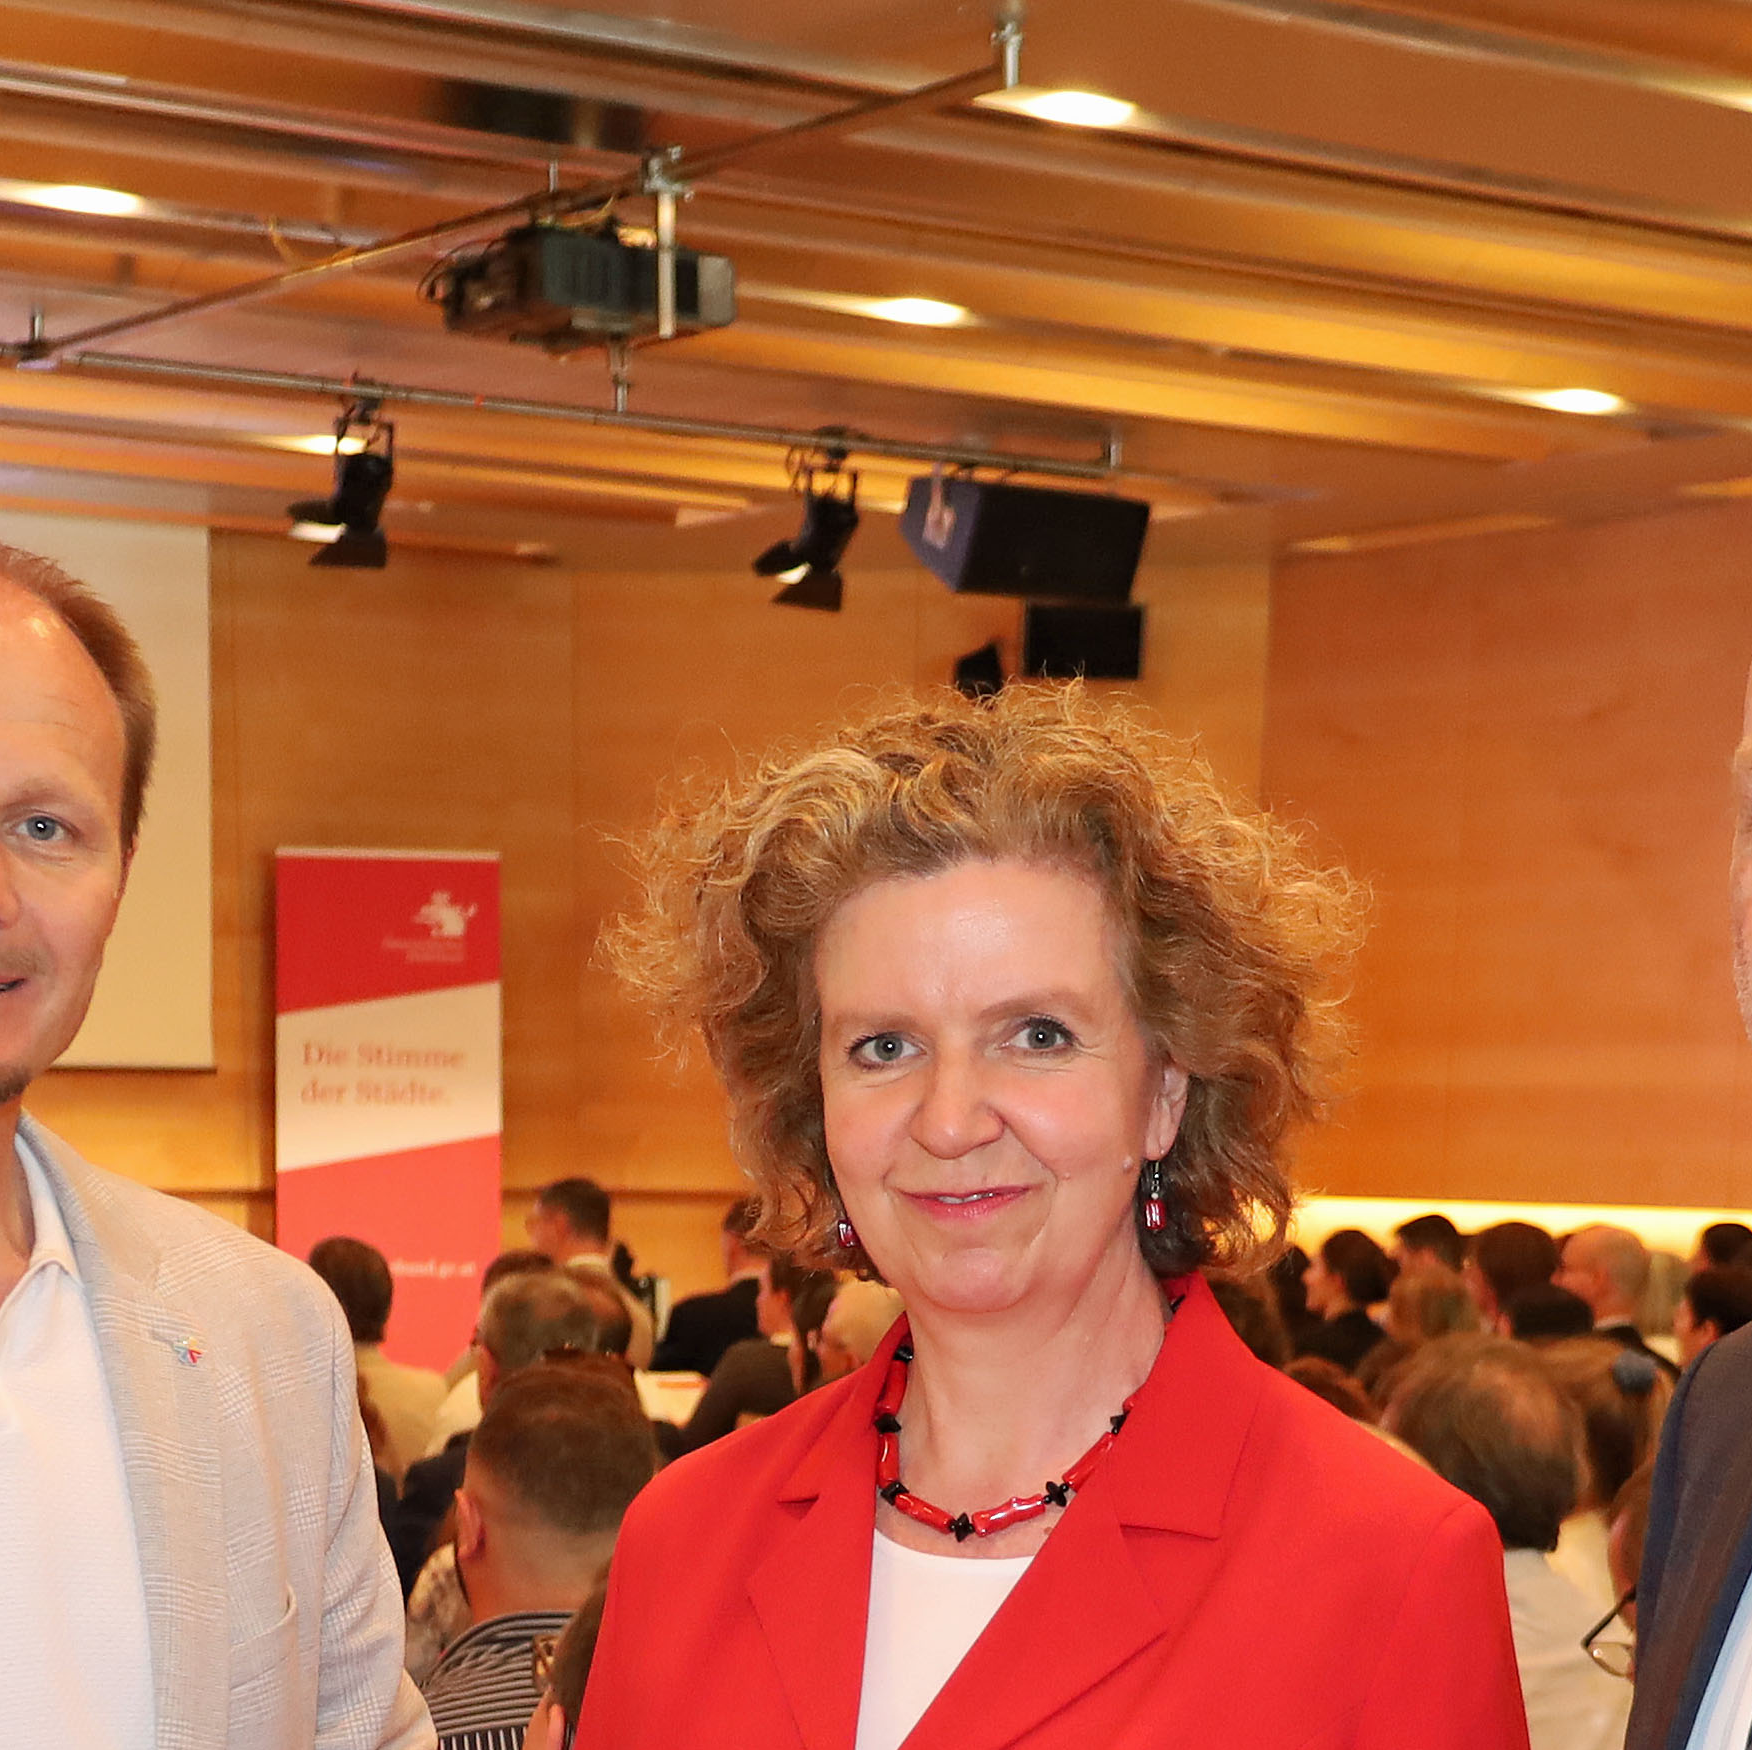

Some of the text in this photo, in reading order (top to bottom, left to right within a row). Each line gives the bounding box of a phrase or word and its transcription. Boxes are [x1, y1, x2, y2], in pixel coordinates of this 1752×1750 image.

[303, 1042, 465, 1069] Die Stimme
[302, 1078, 347, 1104] der
